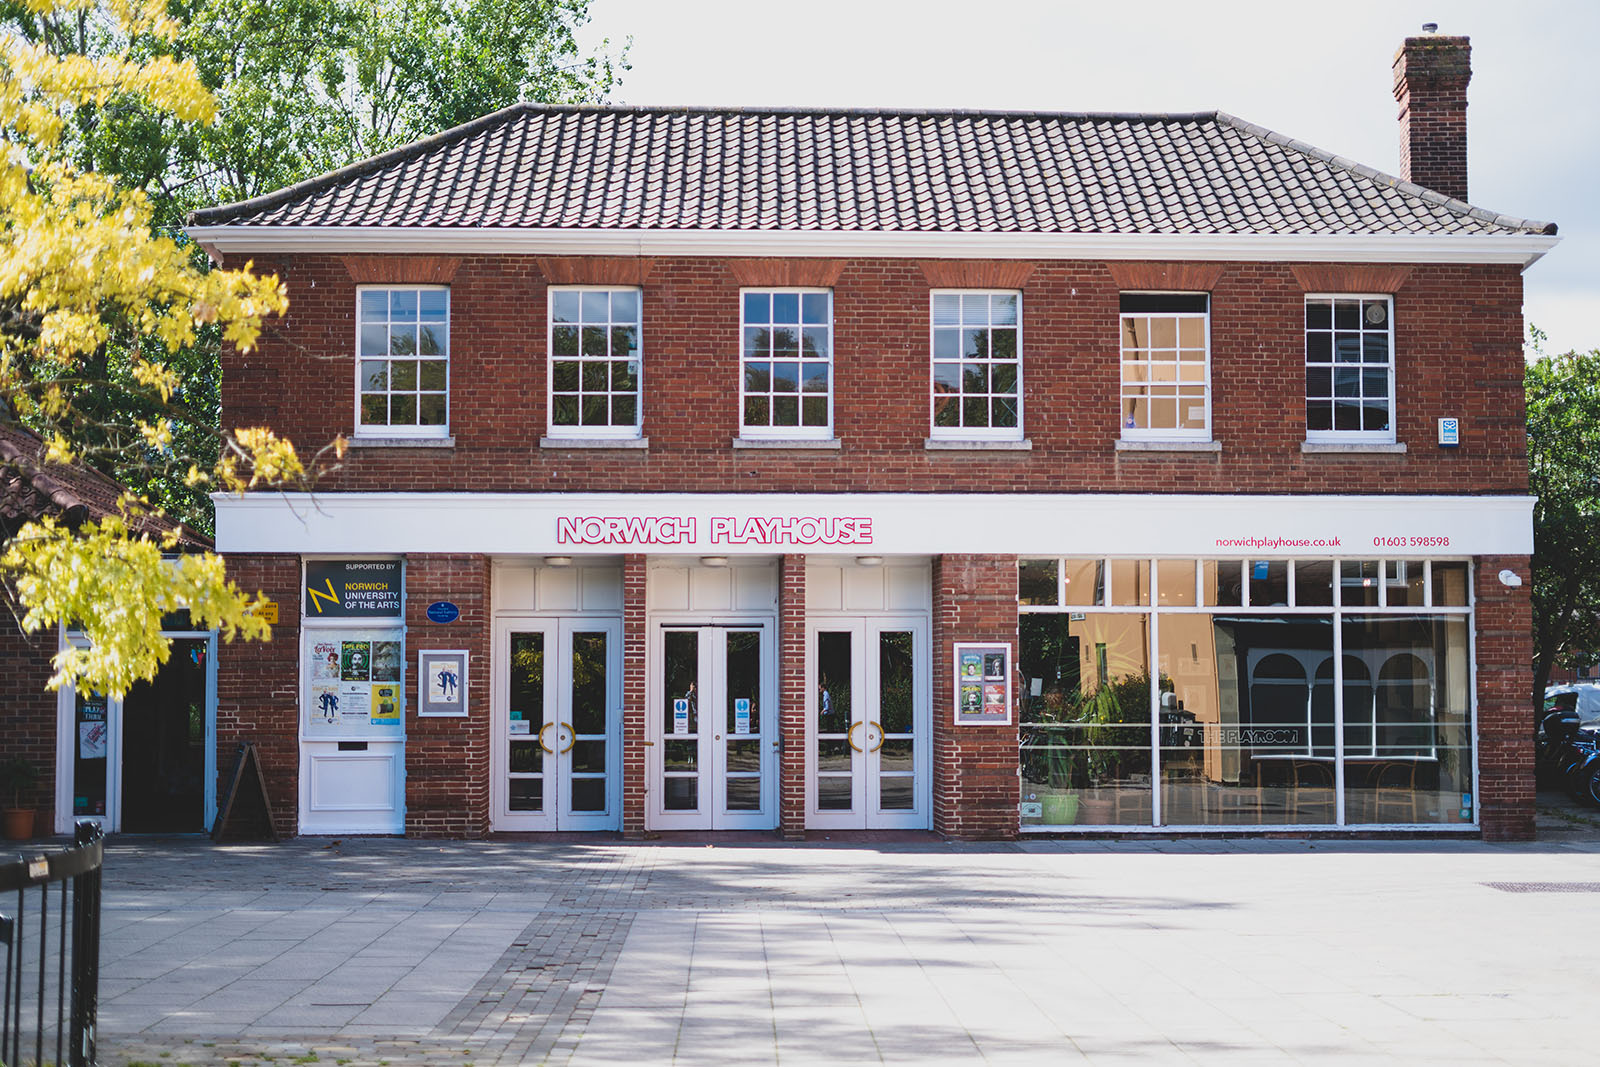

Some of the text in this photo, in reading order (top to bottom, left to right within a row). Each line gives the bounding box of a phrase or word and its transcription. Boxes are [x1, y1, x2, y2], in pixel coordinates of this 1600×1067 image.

[557, 517, 873, 544] NORWICH PLAYHOUSE
[1215, 536, 1341, 549] norwichplayhouse.co.uk
[1373, 536, 1450, 547] 01603 598598
[345, 582, 388, 591] NORWICH
[345, 592, 399, 600] UNIVERSITY
[345, 601, 400, 609] OF THE ARTS
[1197, 729, 1226, 744] THE
